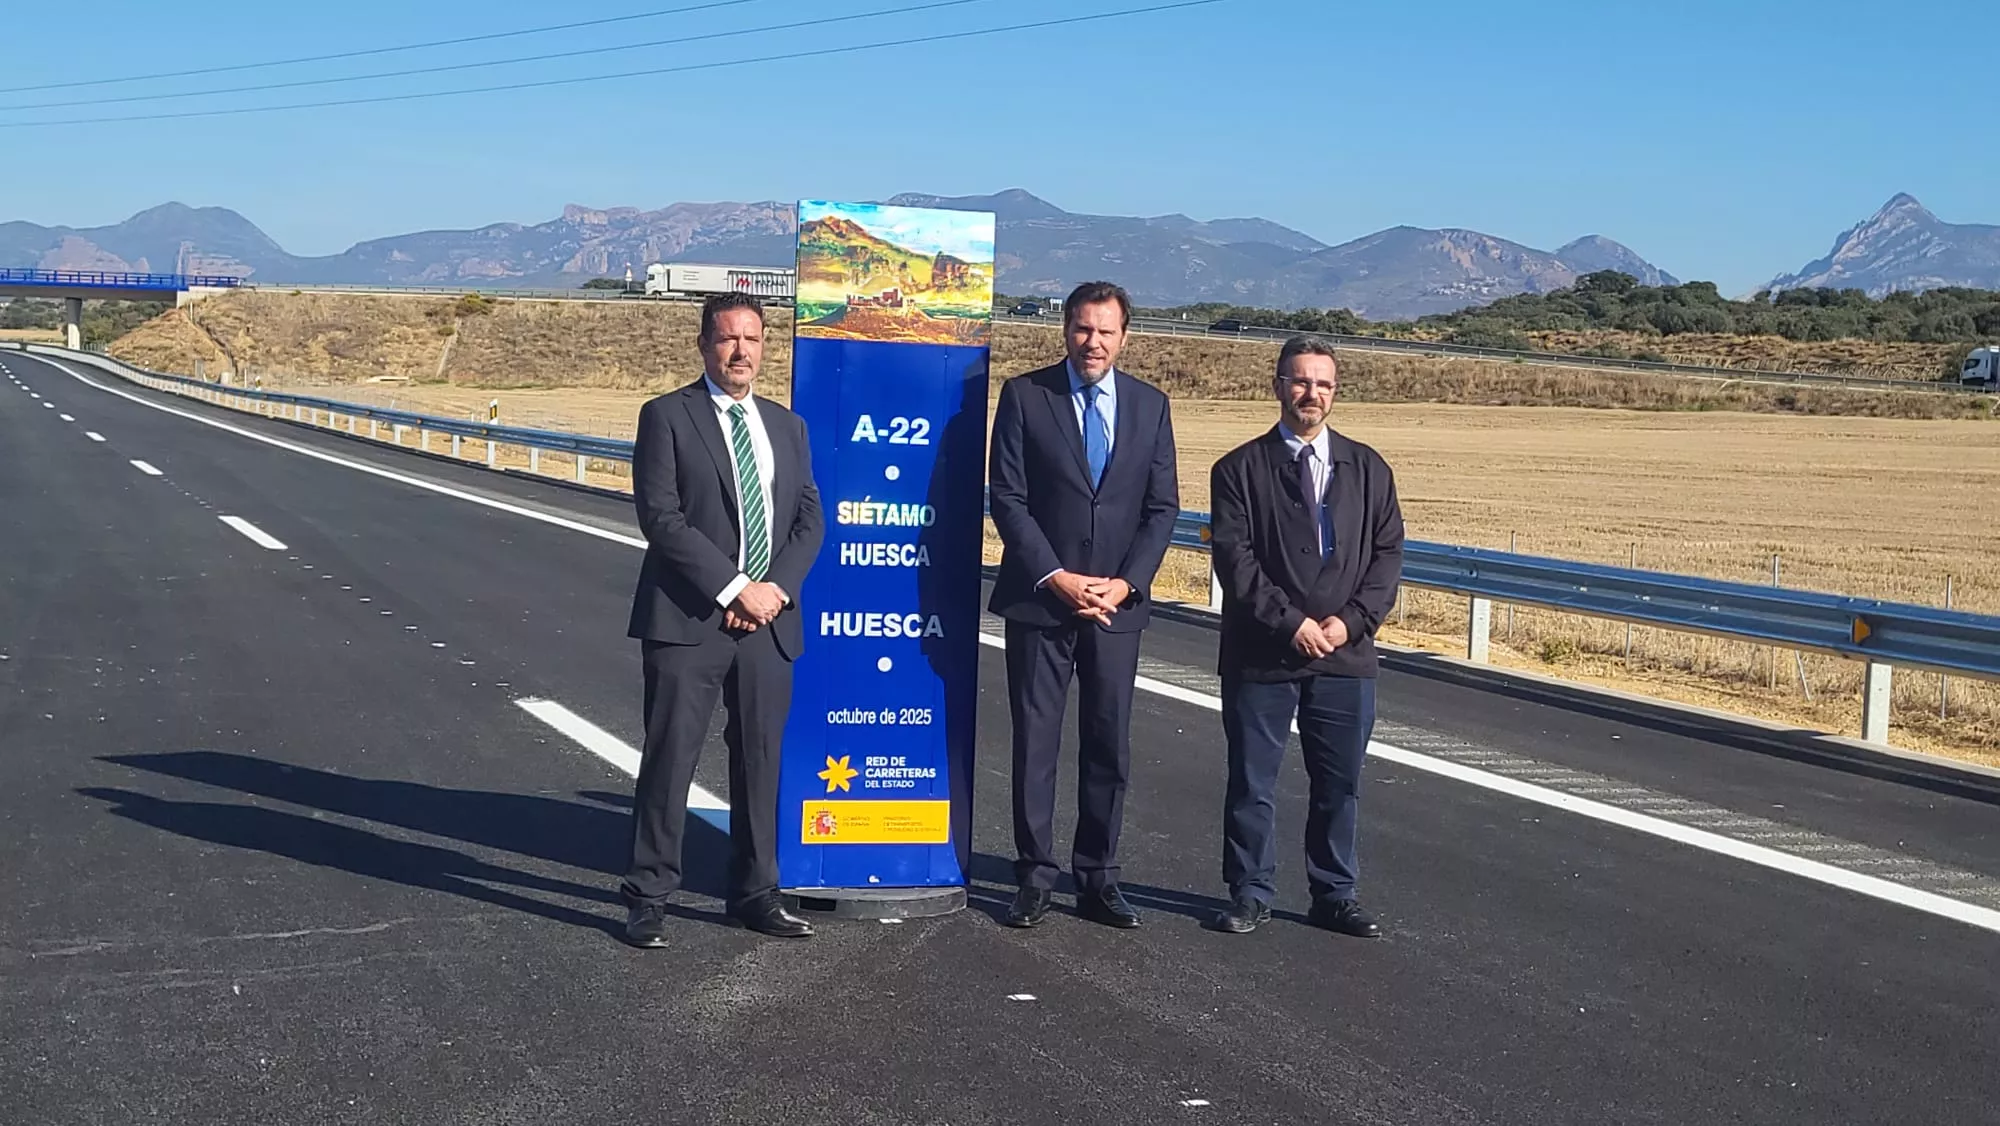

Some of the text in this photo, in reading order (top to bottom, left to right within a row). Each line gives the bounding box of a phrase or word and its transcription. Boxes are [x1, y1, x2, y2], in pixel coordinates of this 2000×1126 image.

[851, 414, 930, 445] A-22
[837, 496, 936, 526] SIÉTAMO
[840, 542, 930, 566] HUESCA
[820, 612, 944, 637] HUESCA
[827, 708, 932, 725] octubre de 2025
[865, 756, 906, 767] RED DE
[865, 768, 936, 778] CARRETERAS
[865, 780, 915, 788] DEL ESTADO
